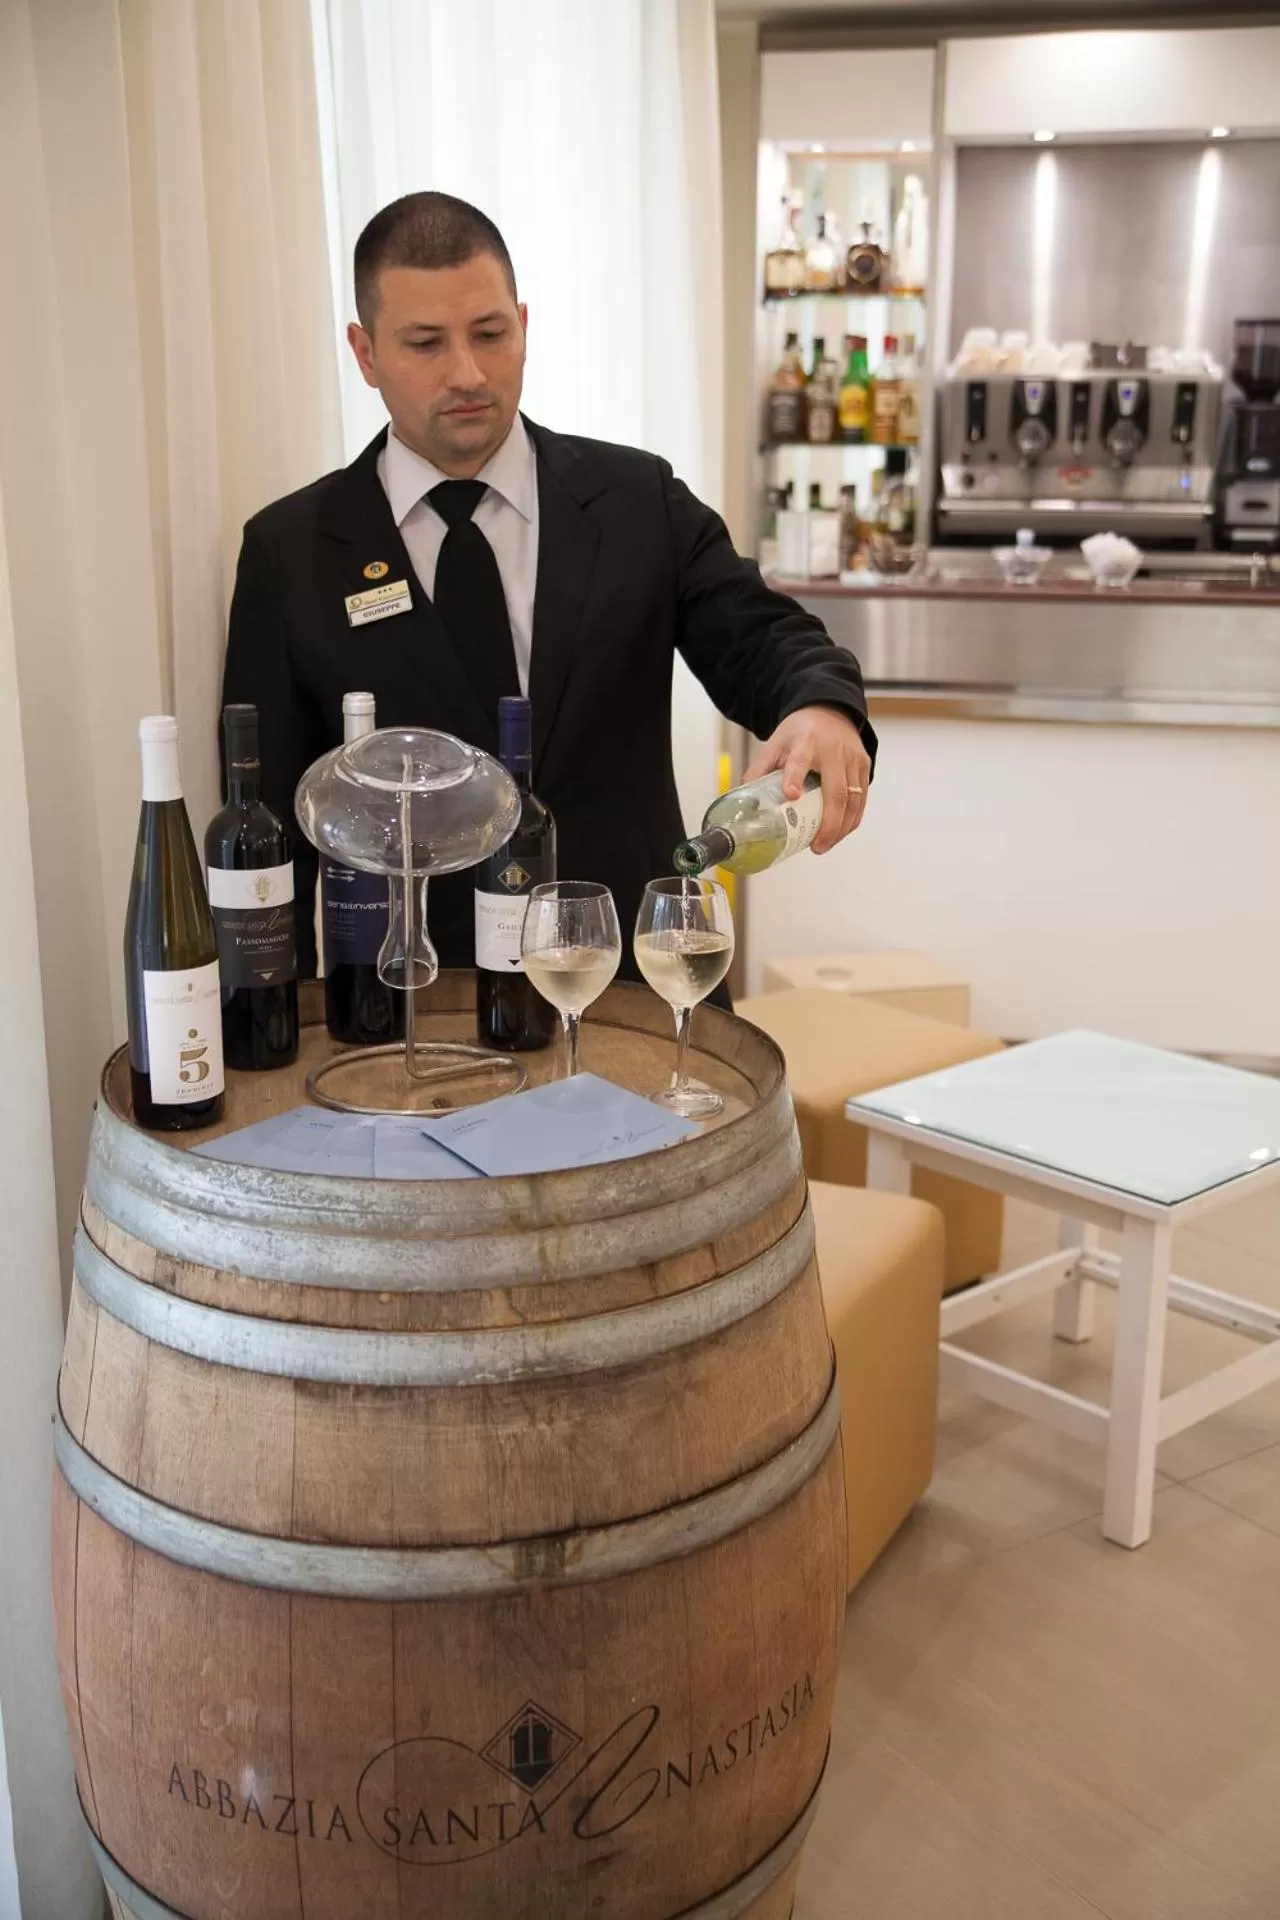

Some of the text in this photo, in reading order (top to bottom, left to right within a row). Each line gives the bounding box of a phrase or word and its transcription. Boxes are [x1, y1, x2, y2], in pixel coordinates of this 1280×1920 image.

[362, 602, 400, 618] GIUSEPPE
[179, 1046, 210, 1084] 5
[167, 1761, 352, 1843] ABBAZIA
[382, 1799, 546, 1846] SANTA
